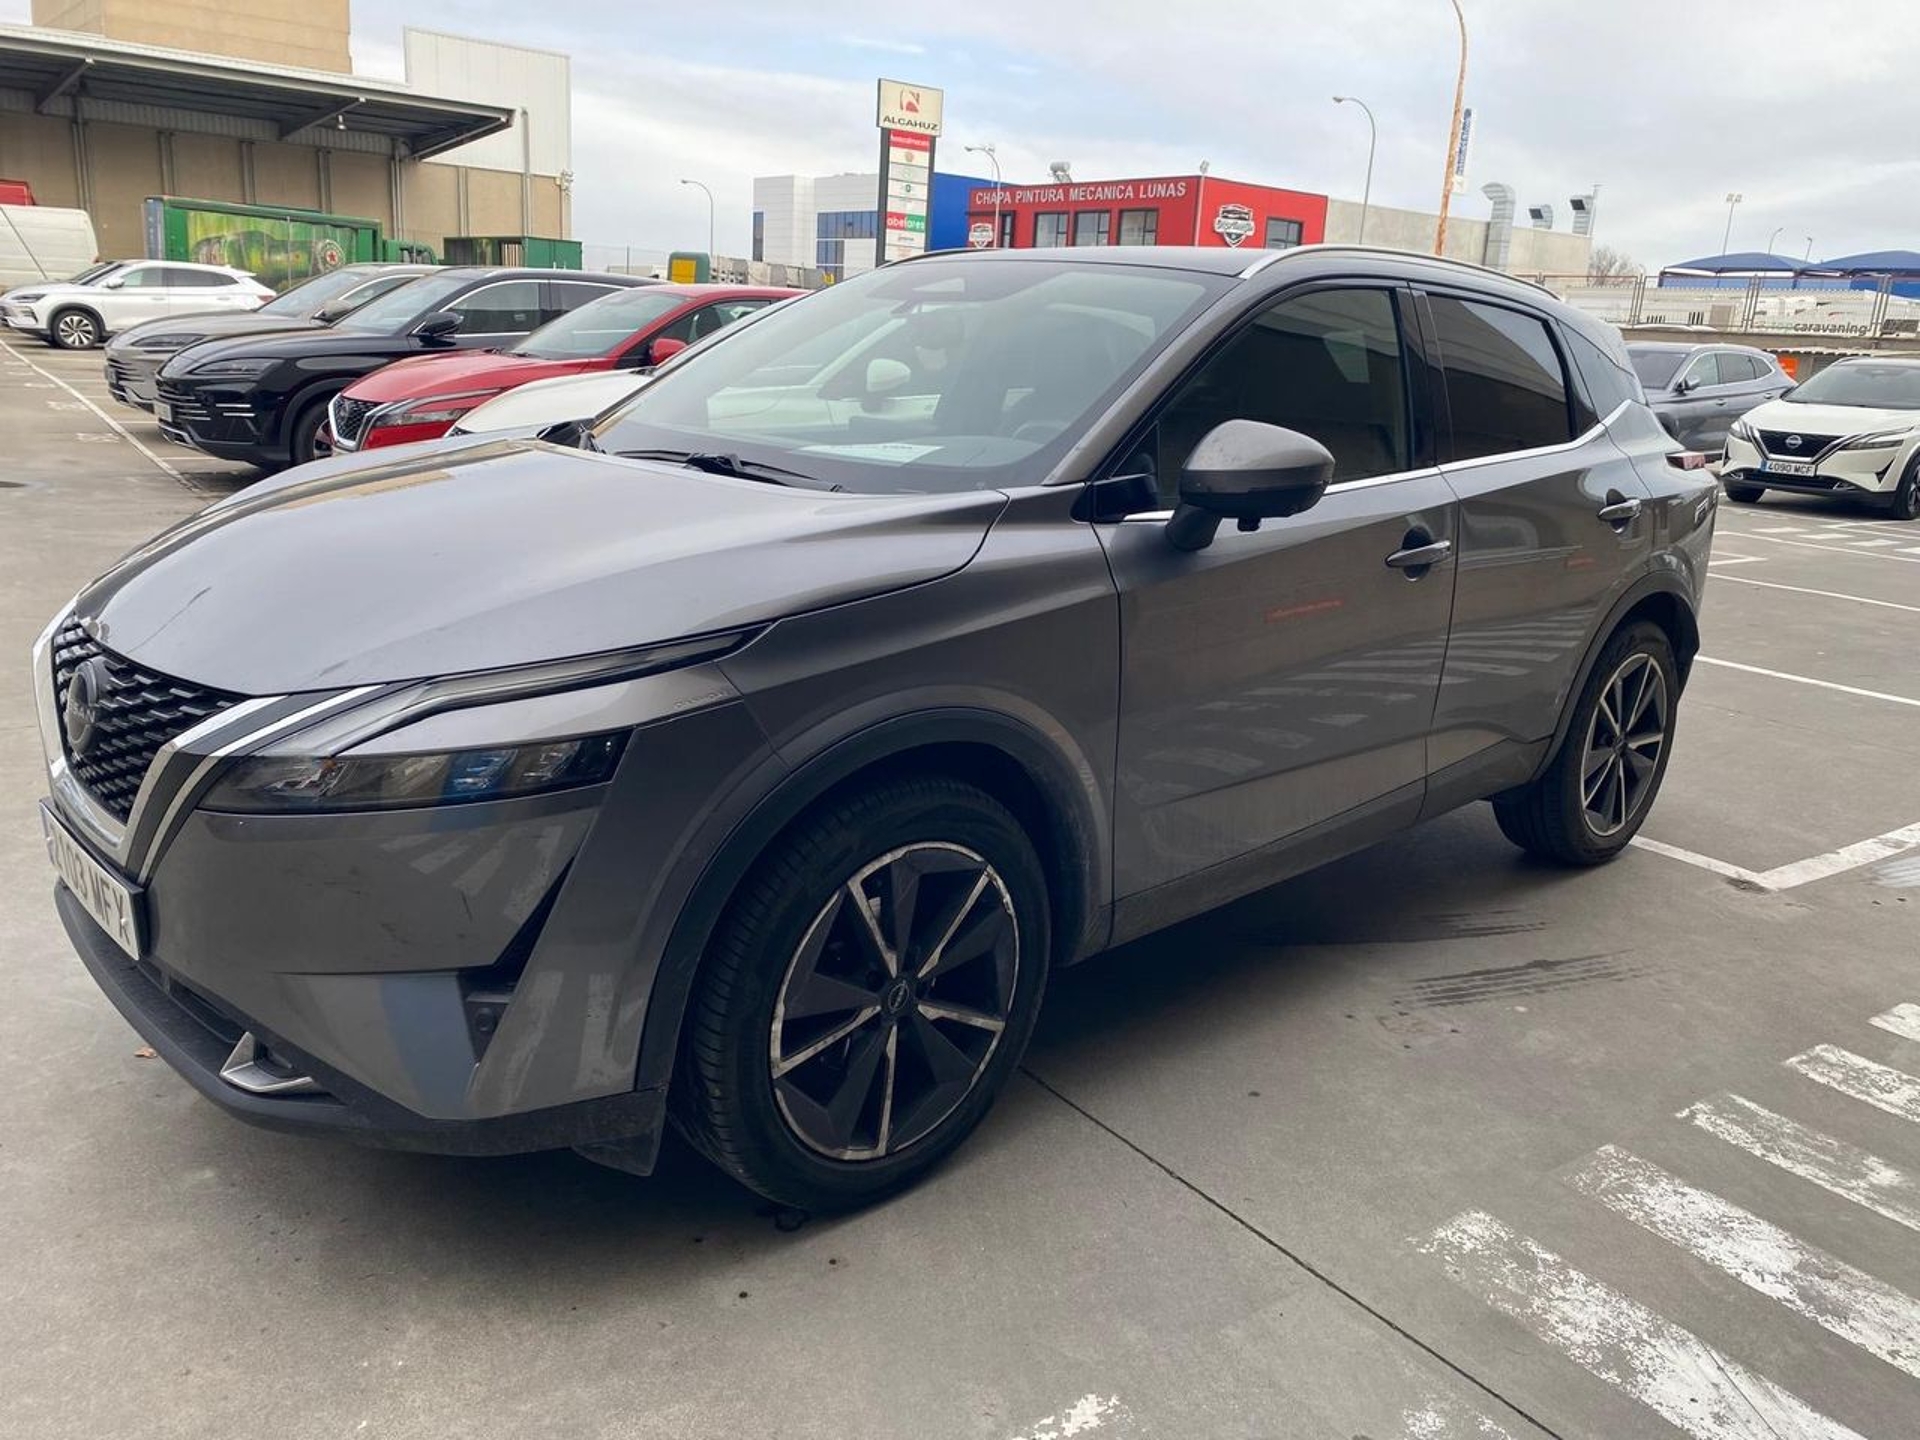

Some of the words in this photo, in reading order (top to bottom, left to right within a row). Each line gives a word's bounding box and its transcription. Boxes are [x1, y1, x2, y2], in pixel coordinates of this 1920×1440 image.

[883, 115, 938, 130] ALCAHUZ
[975, 191, 1012, 205] CHAPA
[1015, 186, 1064, 204] PINTURA
[1069, 184, 1134, 202] MECANICA
[1139, 181, 1186, 199] LUNAS
[1794, 322, 1868, 336] caravaning
[1769, 461, 1791, 471] 4090
[1793, 464, 1813, 474] MCF
